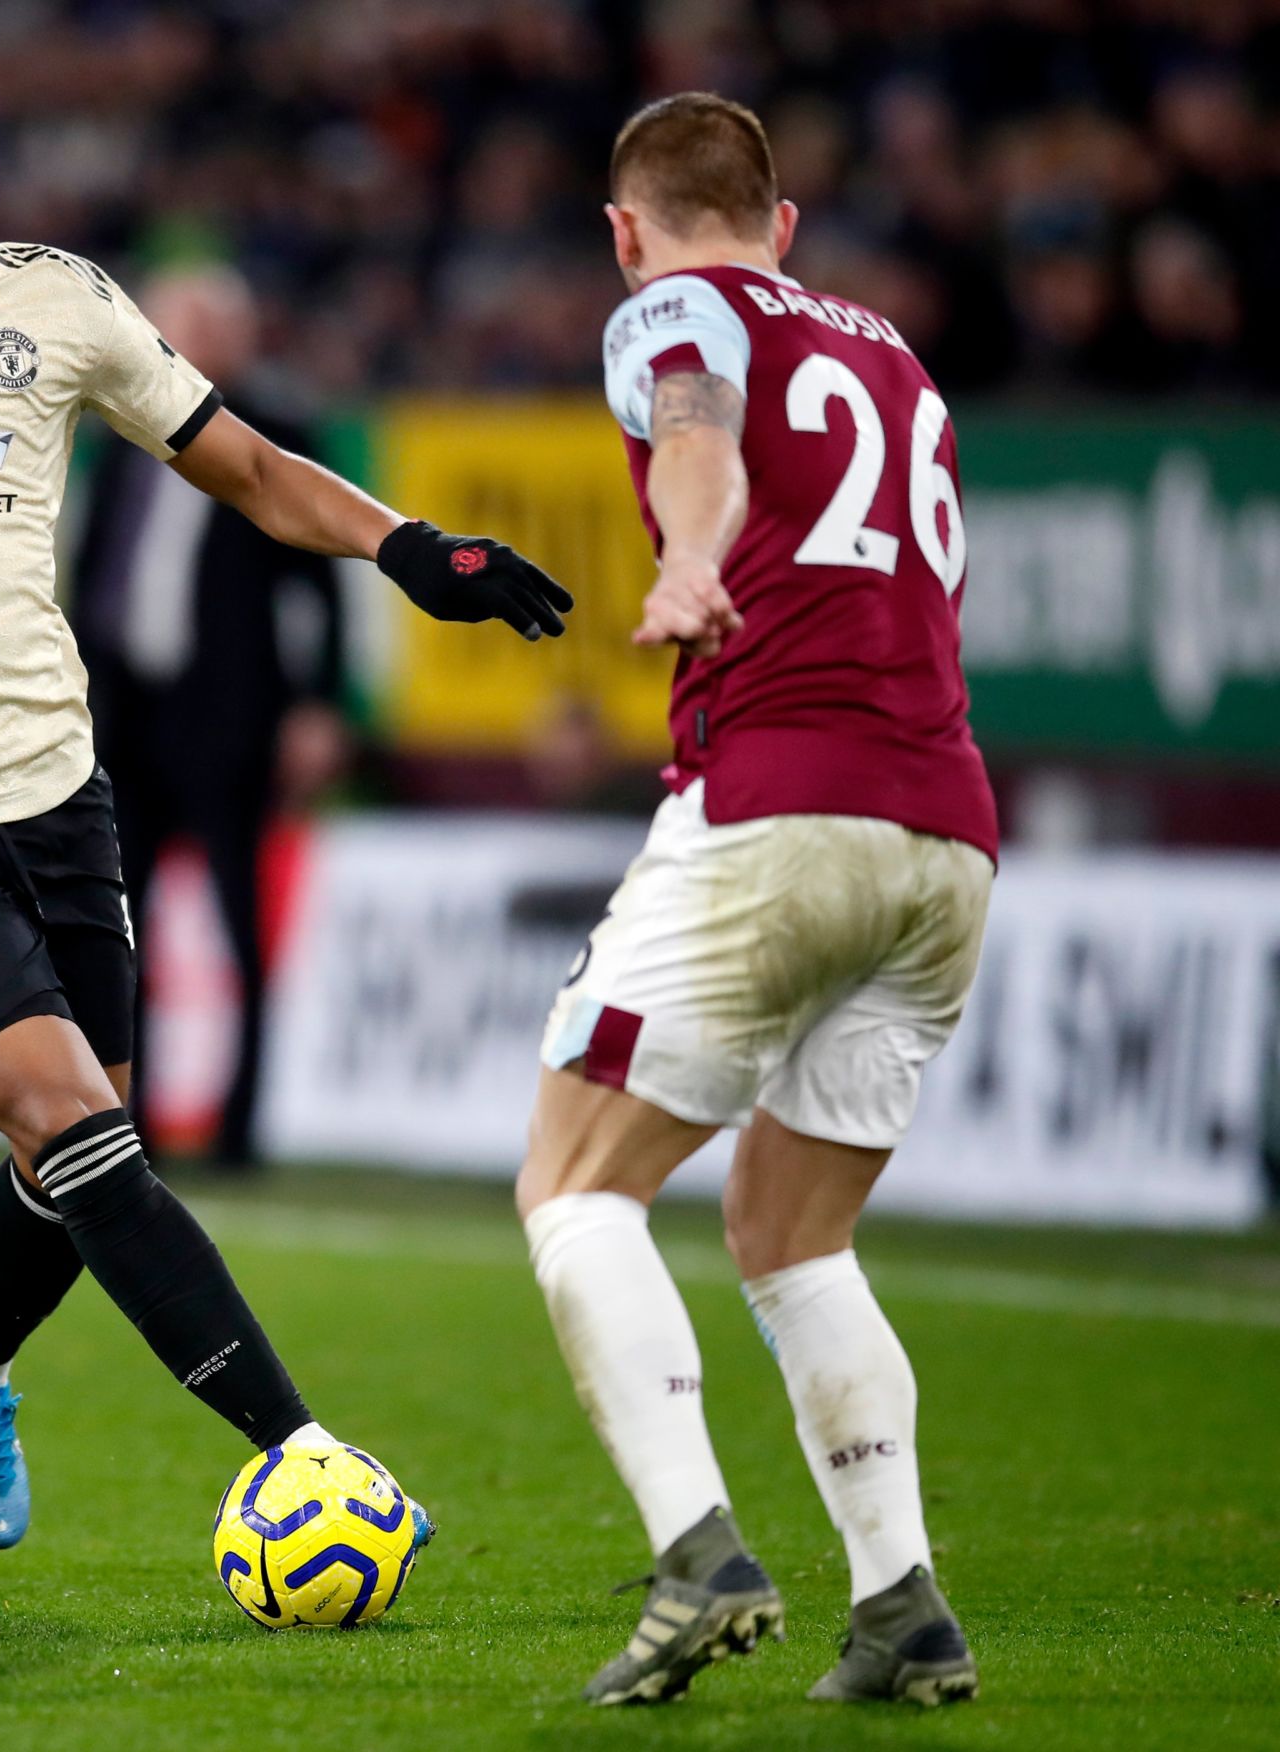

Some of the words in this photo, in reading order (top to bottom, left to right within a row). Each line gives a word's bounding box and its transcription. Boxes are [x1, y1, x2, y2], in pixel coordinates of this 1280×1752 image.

[786, 353, 967, 600] 26
[181, 1340, 241, 1387] ANCHESTER
[192, 1360, 227, 1386] UNITED
